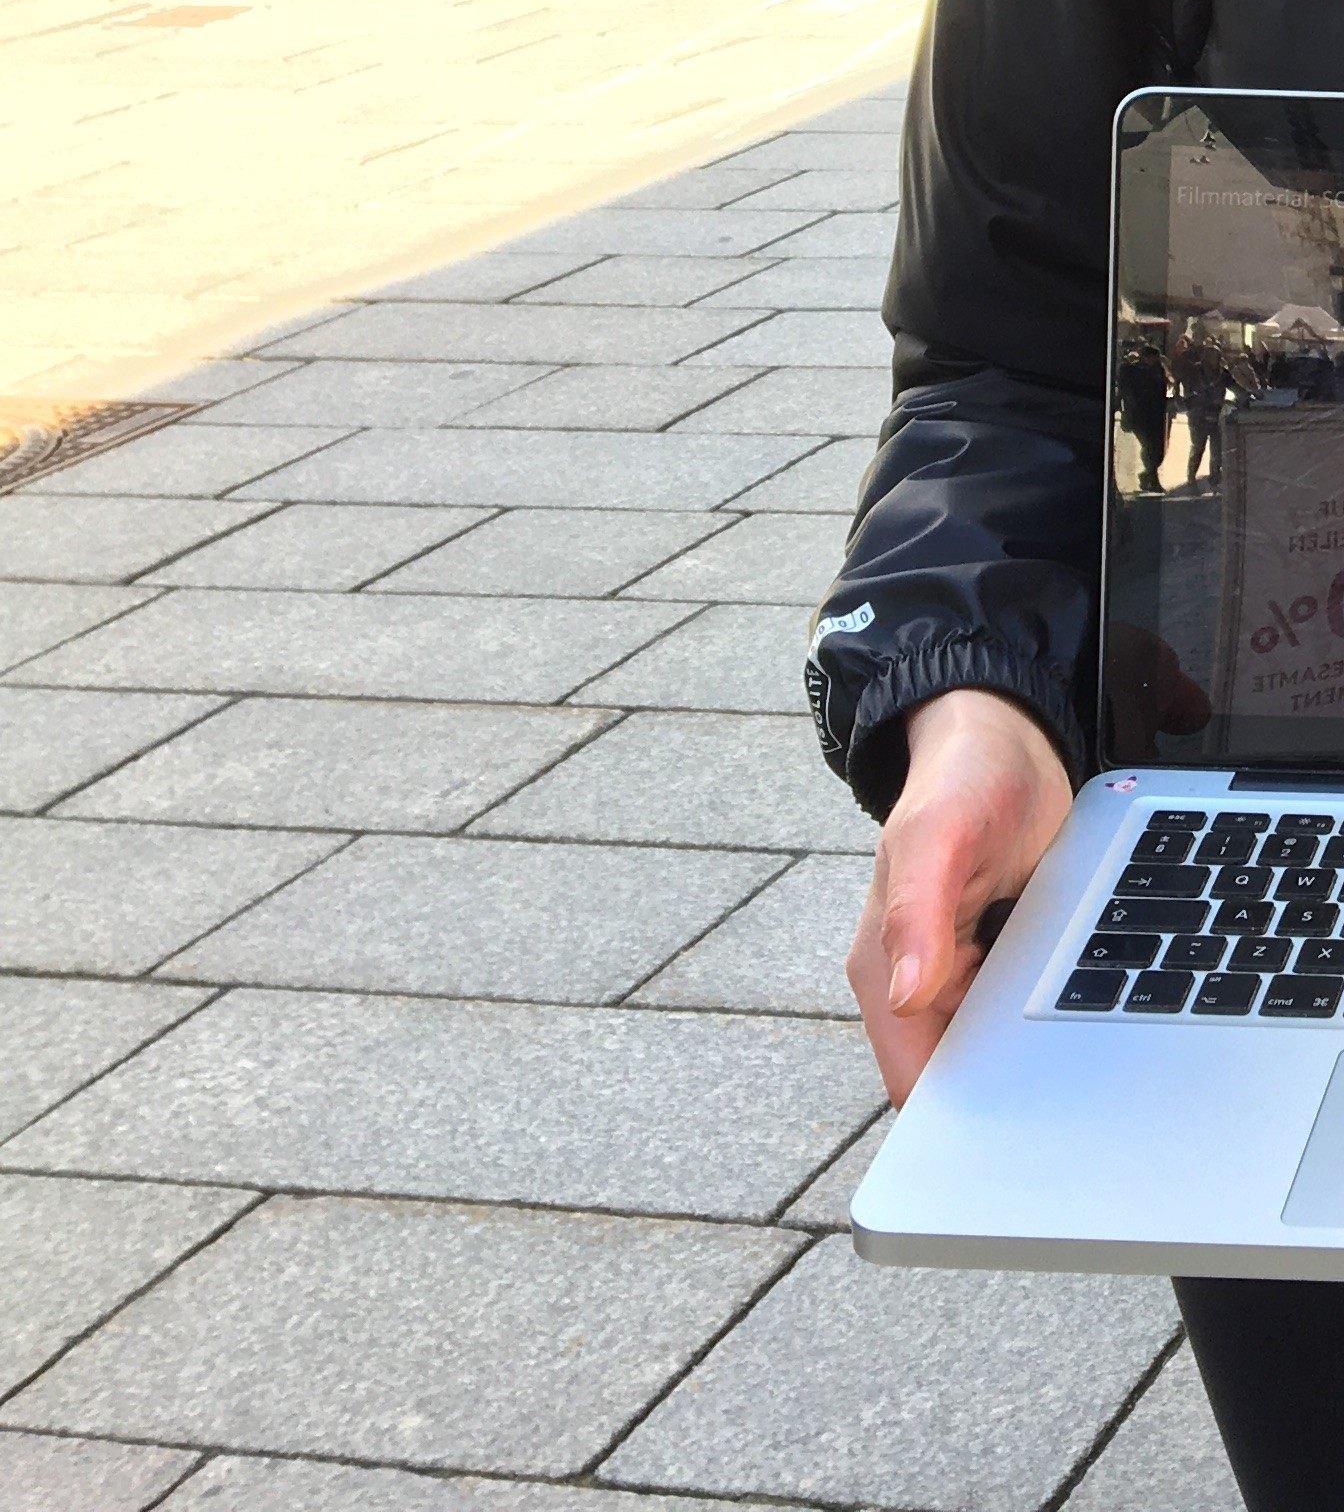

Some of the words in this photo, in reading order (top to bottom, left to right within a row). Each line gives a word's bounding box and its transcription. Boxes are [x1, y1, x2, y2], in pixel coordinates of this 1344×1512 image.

[806, 668, 829, 746] ISOLITE
[1235, 875, 1249, 886] Q
[1297, 876, 1315, 887] W
[1234, 909, 1248, 920] A
[1302, 911, 1313, 922] S
[1252, 945, 1267, 957] Z
[1317, 947, 1333, 959] X
[1132, 993, 1151, 1002] ctrl
[1268, 997, 1294, 1006] cmd
